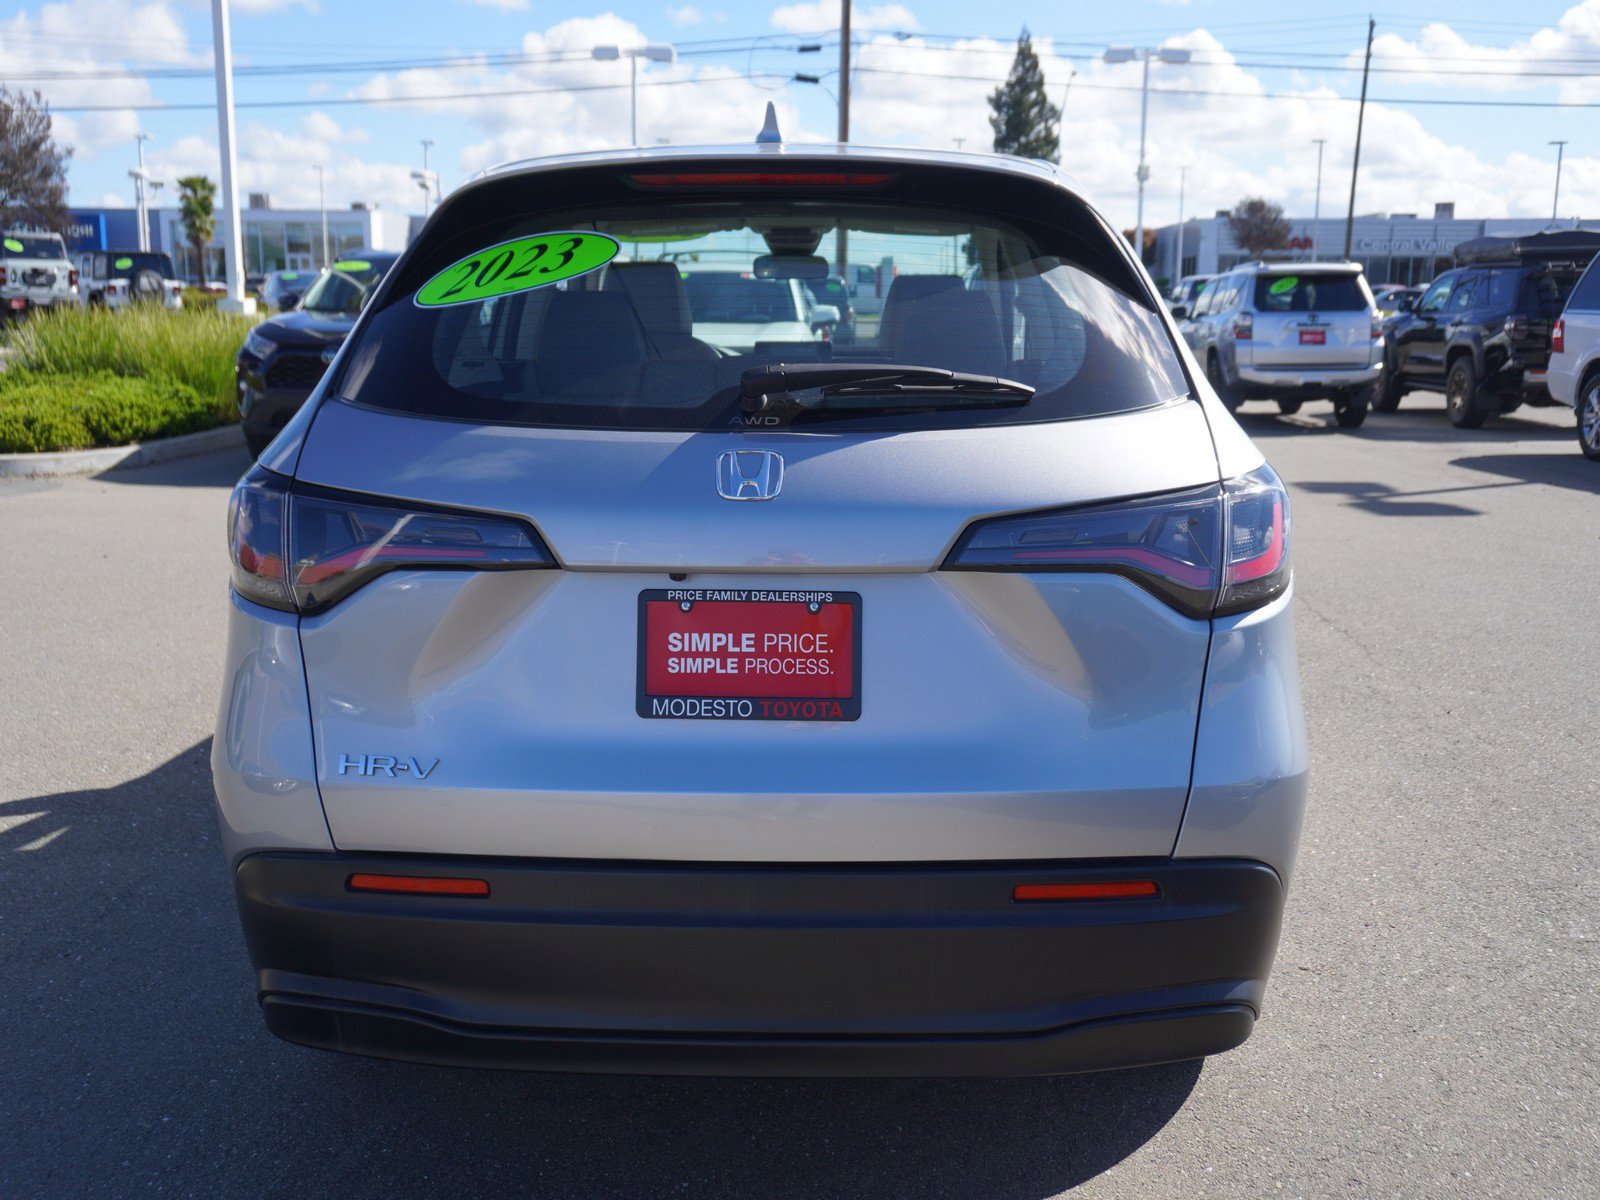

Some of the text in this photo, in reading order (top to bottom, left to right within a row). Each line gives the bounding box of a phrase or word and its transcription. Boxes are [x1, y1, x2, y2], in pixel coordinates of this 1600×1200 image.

[1360, 237, 1414, 250] Central
[437, 237, 584, 300] 2023
[728, 416, 780, 426] AWD
[667, 590, 833, 603] PRICE FAMILY DEALERSHIPS
[667, 632, 834, 653] SIMPLE PRICE.
[667, 657, 834, 675] SIMPLE PROCESS.
[652, 698, 843, 719] MODESTO TOYOTA
[338, 753, 440, 779] HR-V
